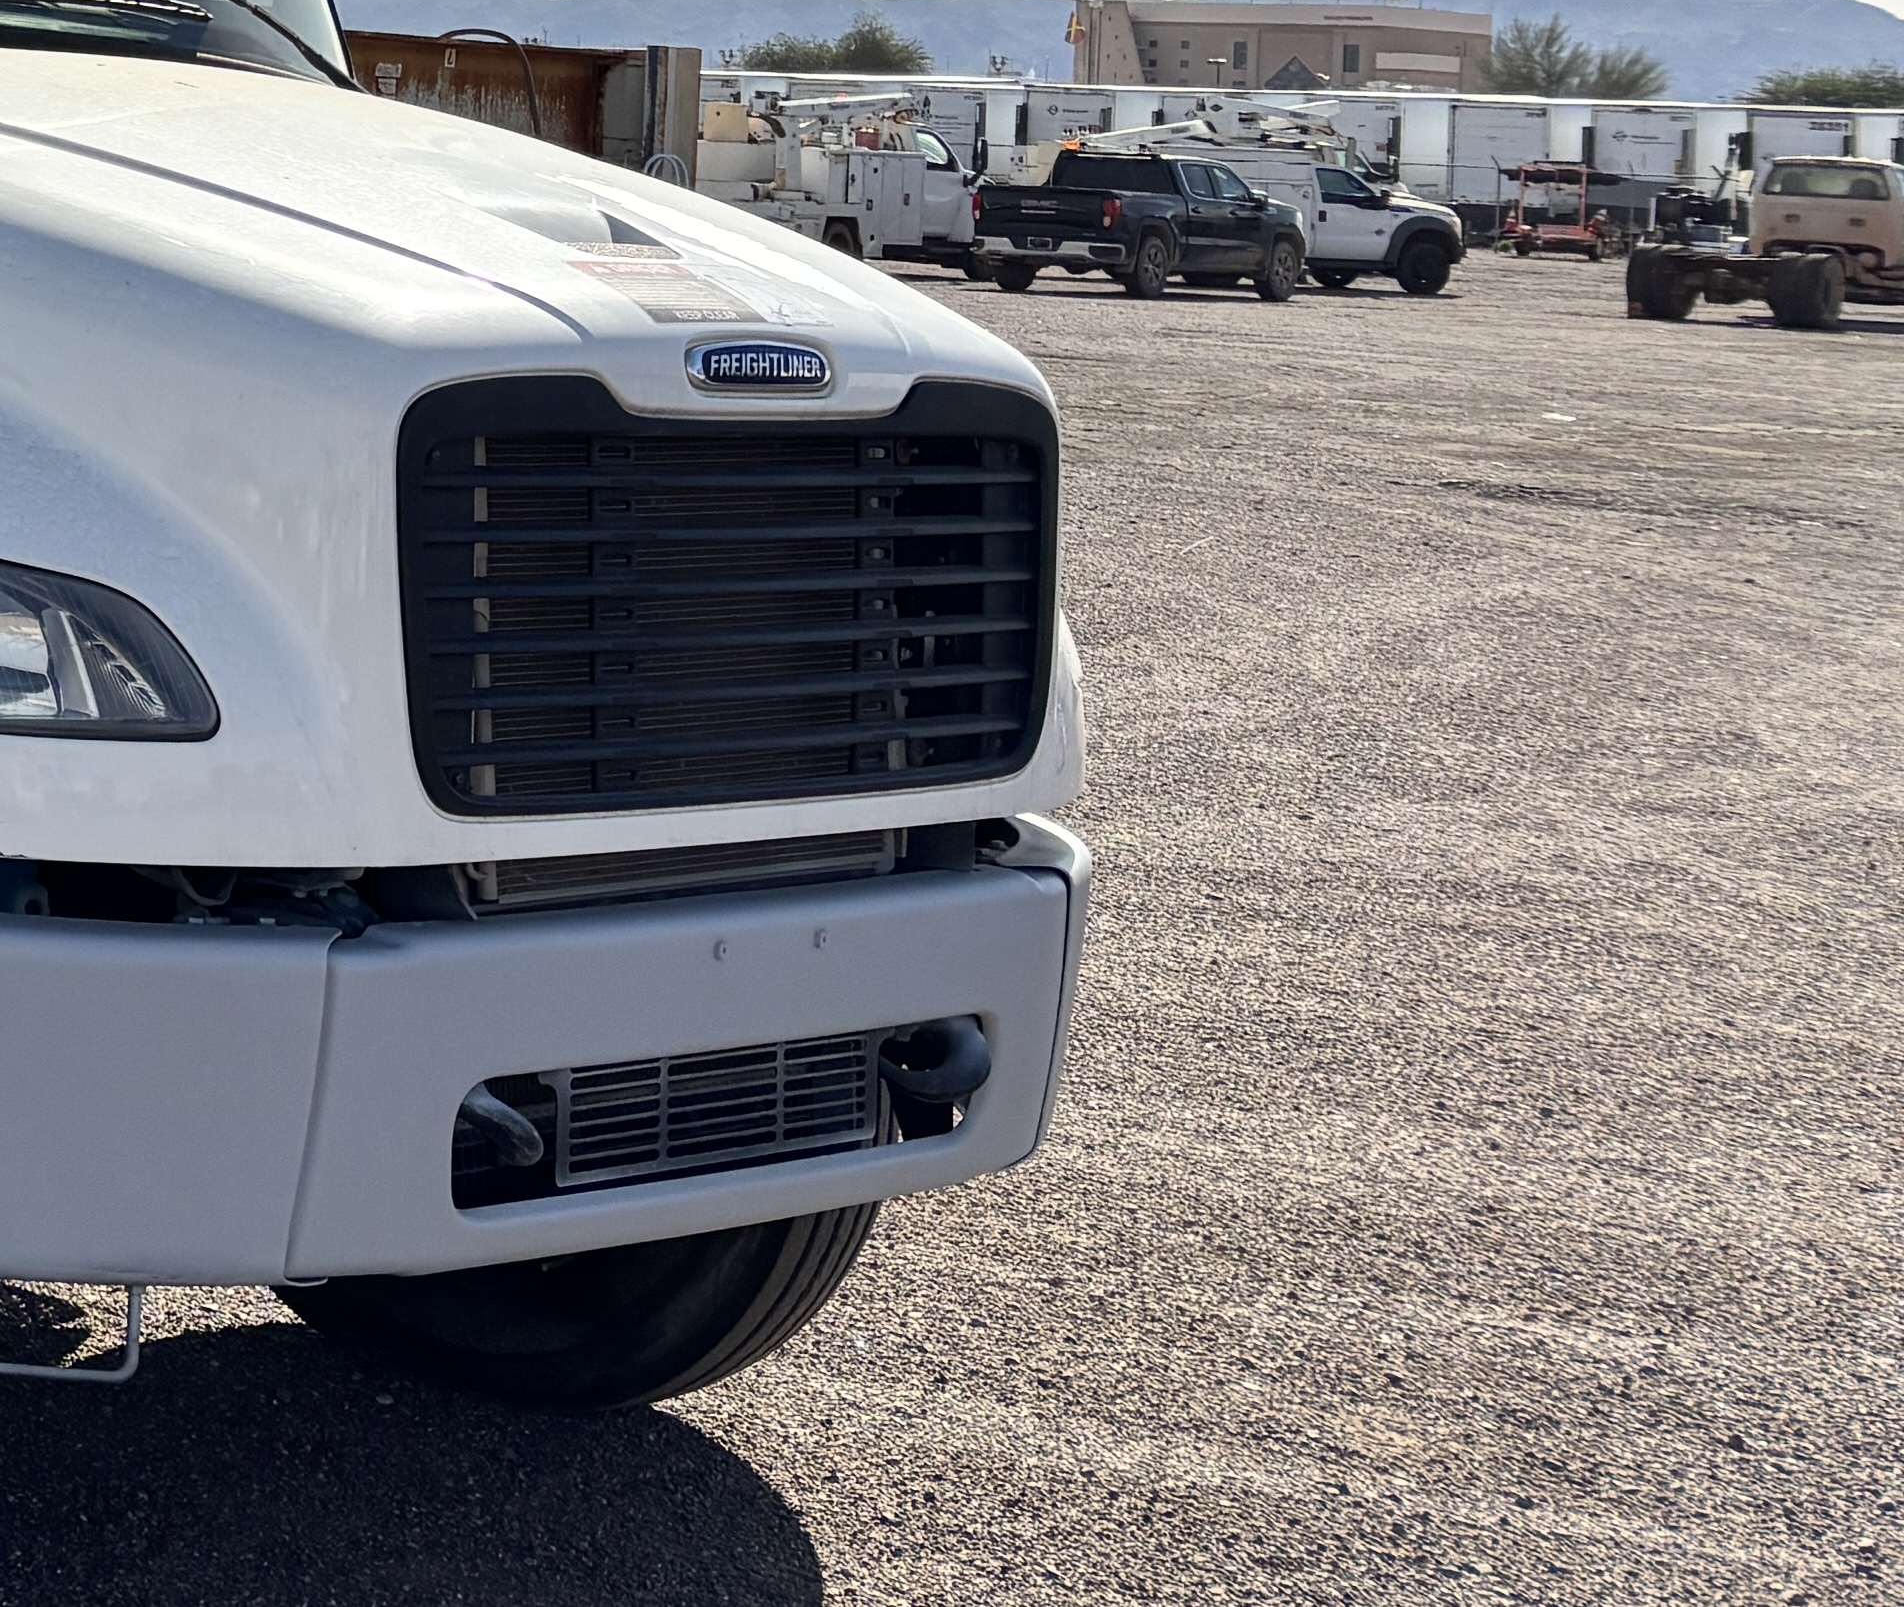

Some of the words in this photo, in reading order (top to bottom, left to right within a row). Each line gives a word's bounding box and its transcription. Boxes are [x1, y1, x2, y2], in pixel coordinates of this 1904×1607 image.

[1021, 199, 1058, 208] GMC
[673, 309, 702, 320] KEEP
[703, 309, 741, 321] CLEAR
[710, 352, 822, 379] FREIGHTLINER
